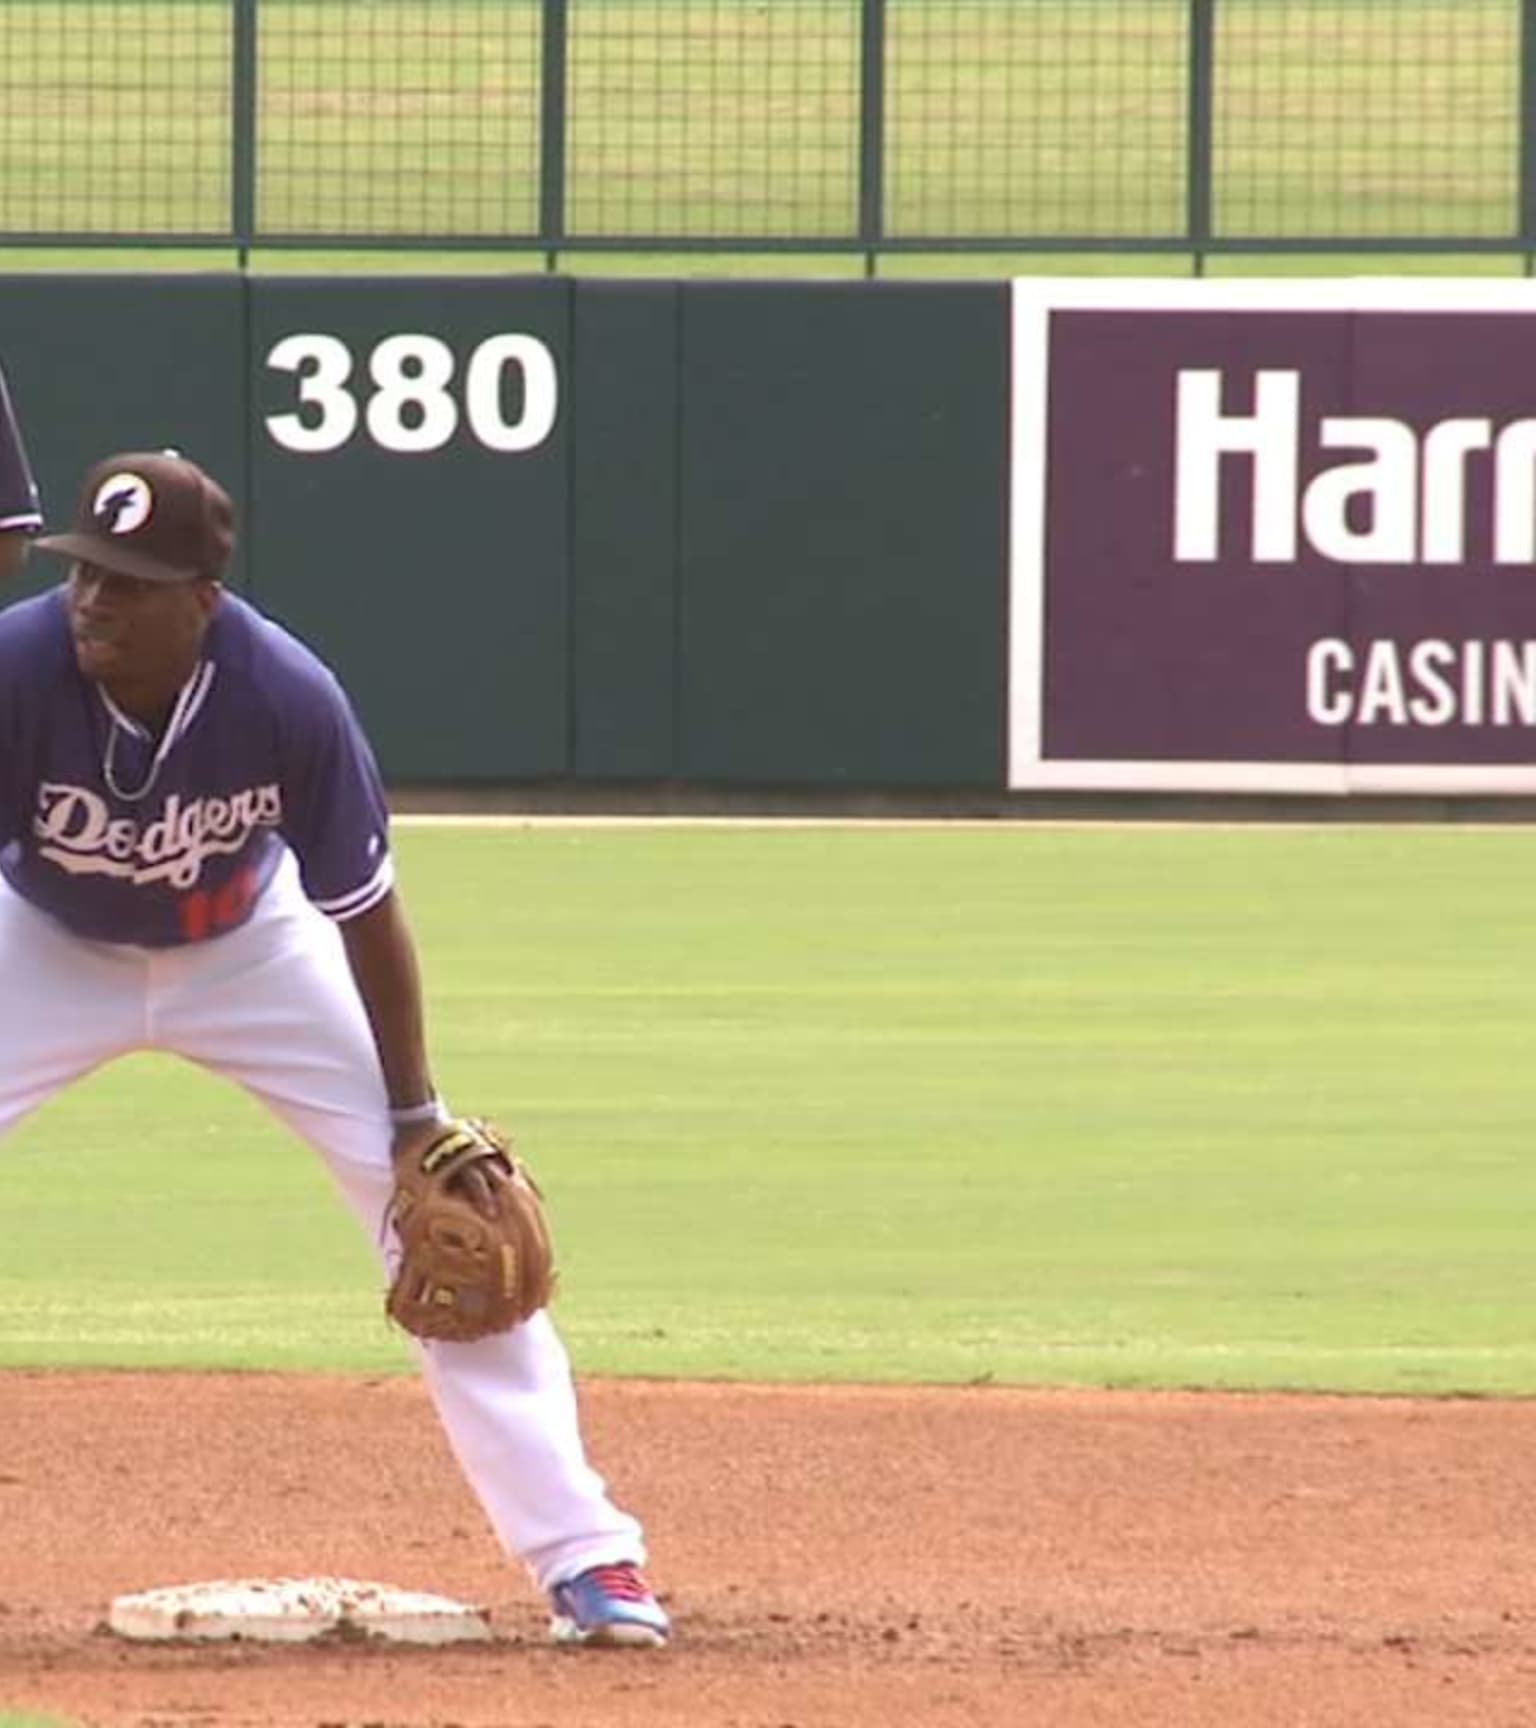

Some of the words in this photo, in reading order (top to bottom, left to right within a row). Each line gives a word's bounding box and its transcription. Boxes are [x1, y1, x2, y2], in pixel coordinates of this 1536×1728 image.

[265, 333, 558, 453] 380
[1306, 638, 1536, 726] CASIN
[34, 781, 283, 888] Dodgers
